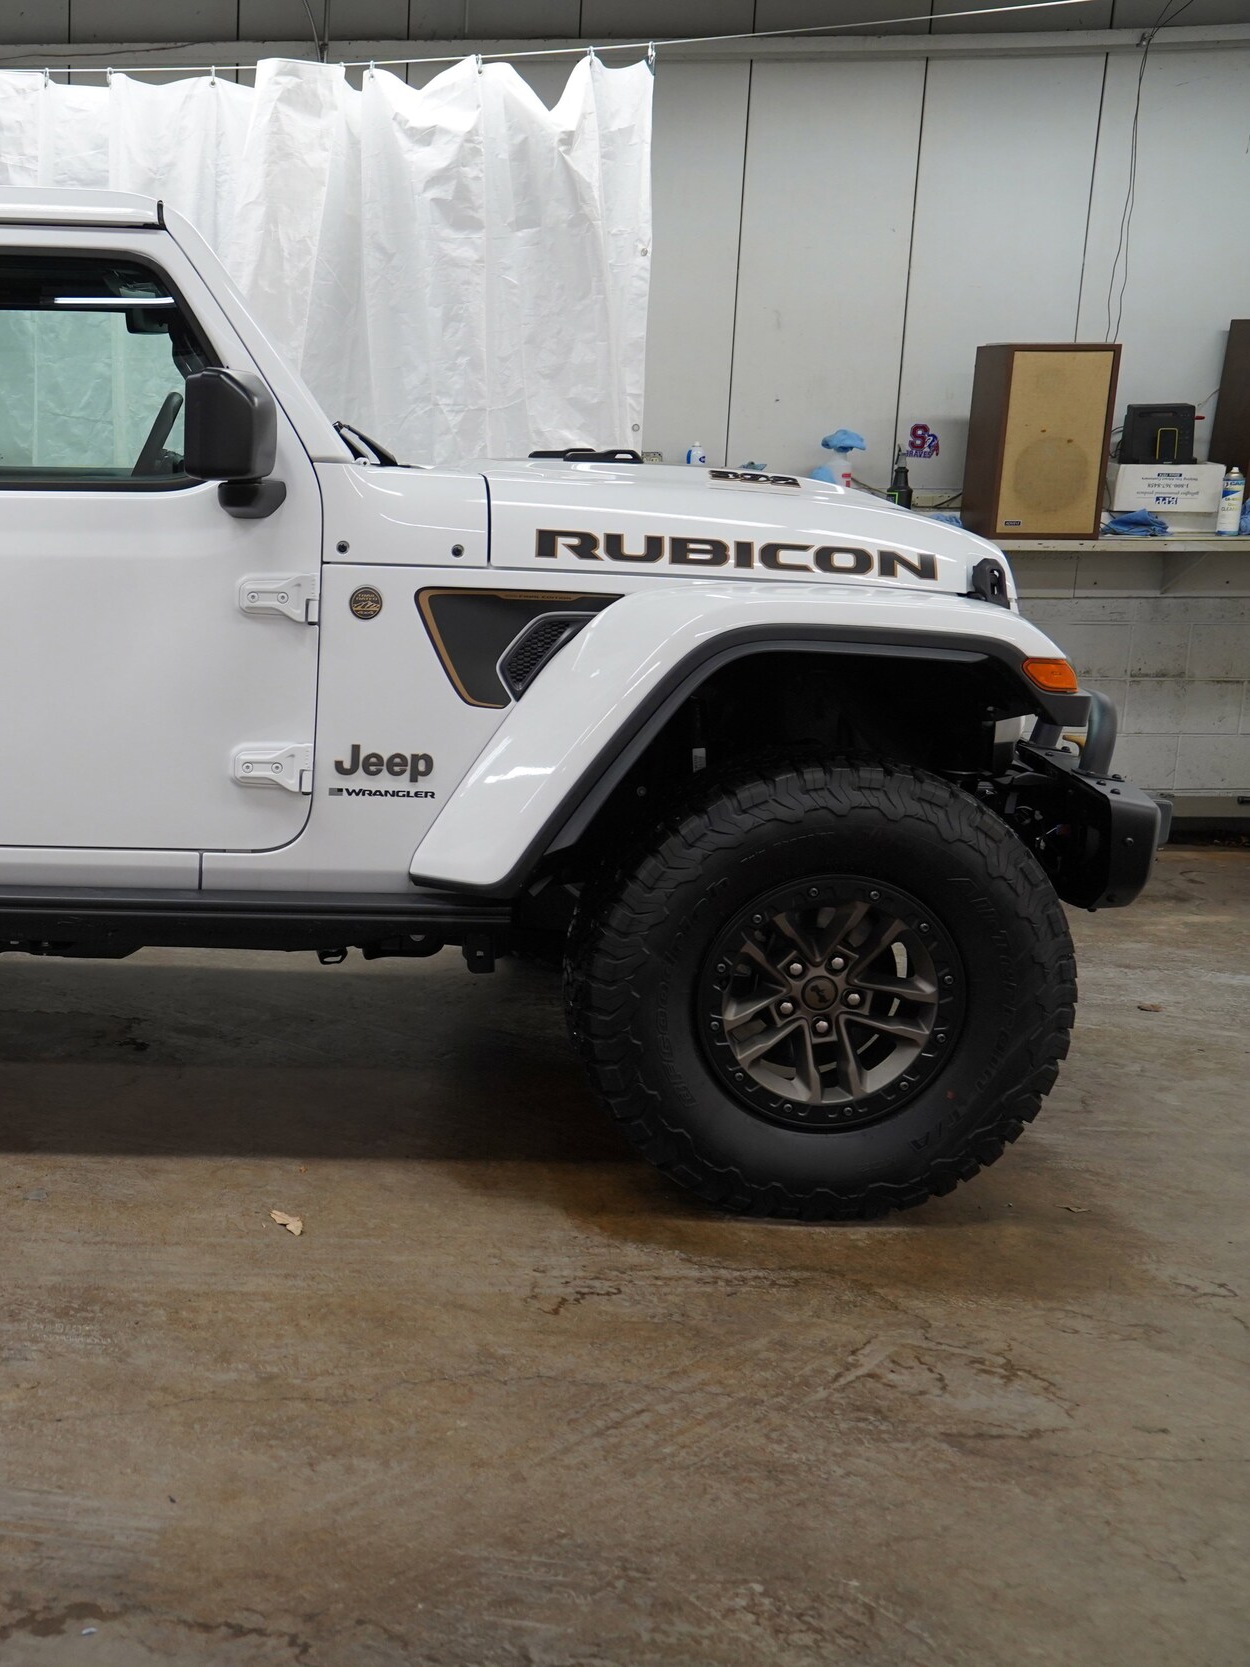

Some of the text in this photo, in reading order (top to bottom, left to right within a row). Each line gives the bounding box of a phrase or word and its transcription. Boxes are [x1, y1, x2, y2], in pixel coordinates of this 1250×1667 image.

[535, 528, 938, 581] RUBICON
[334, 744, 433, 783] Jeep
[344, 788, 436, 799] WRANGLER
